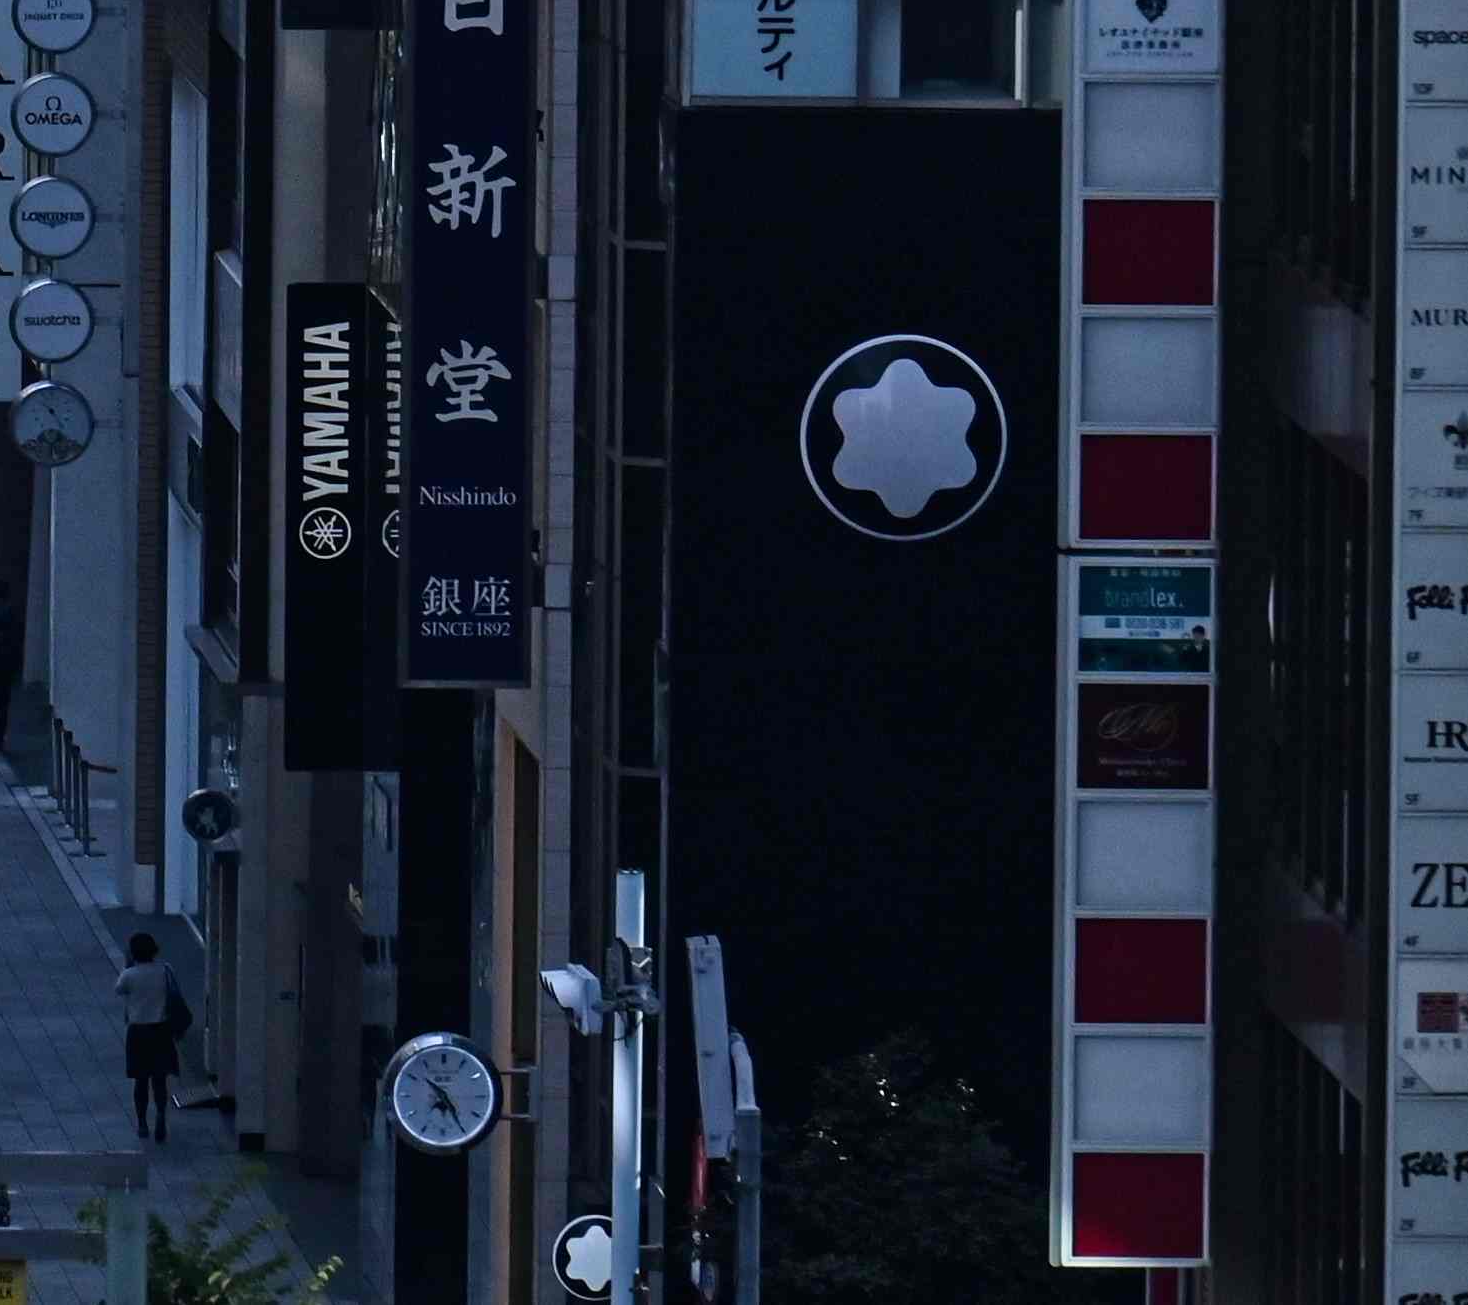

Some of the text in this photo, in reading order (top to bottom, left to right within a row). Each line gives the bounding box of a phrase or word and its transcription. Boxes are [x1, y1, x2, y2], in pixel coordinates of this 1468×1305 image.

[24, 112, 83, 126] OMEGA
[21, 210, 85, 222] LONGINES
[303, 321, 350, 501] YAMAHA
[419, 484, 517, 508] Nisshindo
[420, 576, 513, 619] 銀座
[420, 620, 512, 638] SINCE 1892
